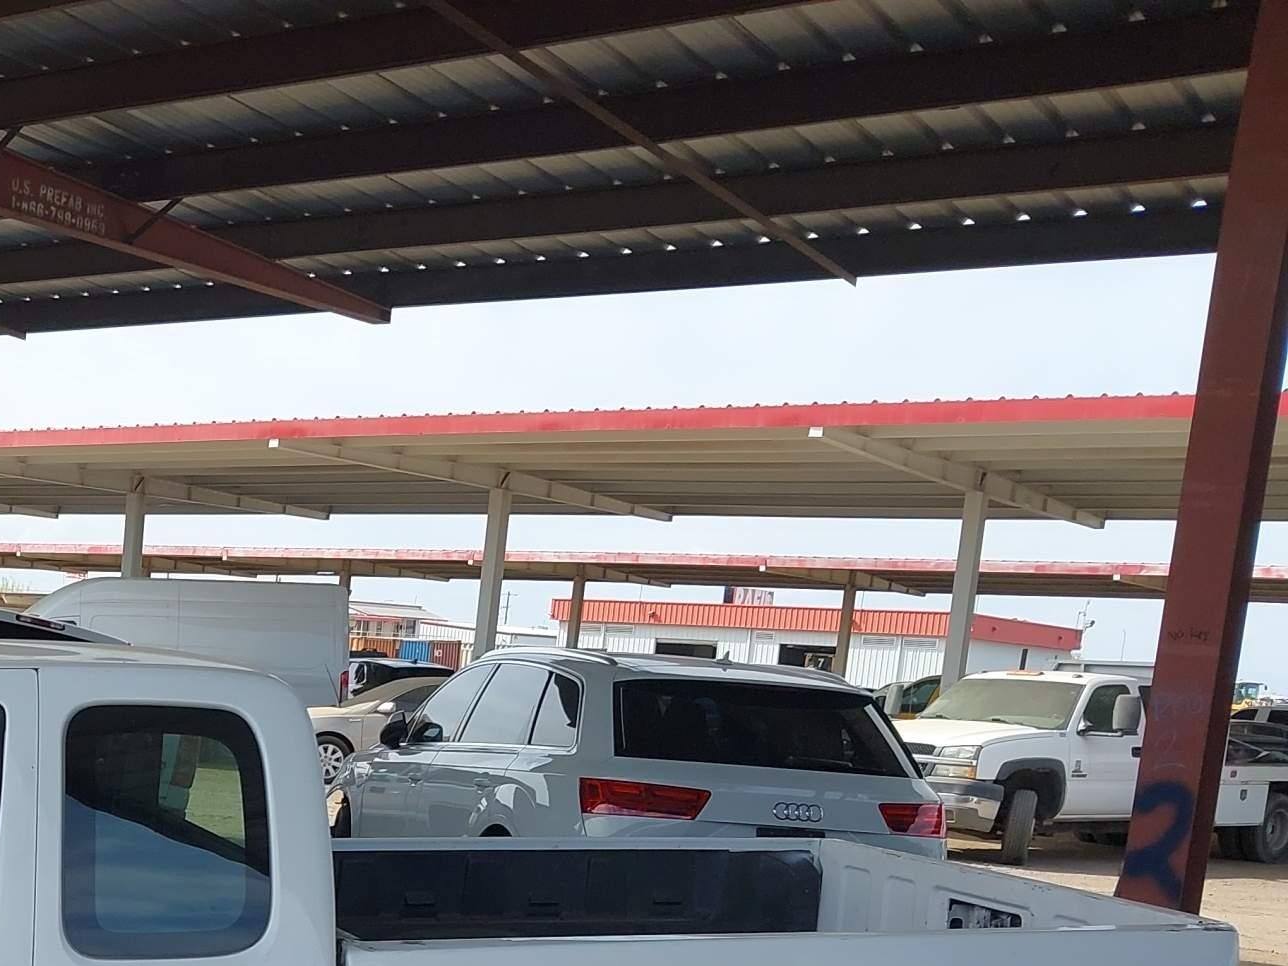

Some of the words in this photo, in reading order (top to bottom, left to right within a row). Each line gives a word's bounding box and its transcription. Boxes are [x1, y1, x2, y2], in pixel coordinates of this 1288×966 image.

[12, 177, 34, 197] U.S.
[38, 184, 83, 212] PREFAB
[1126, 779, 1194, 903] 2
